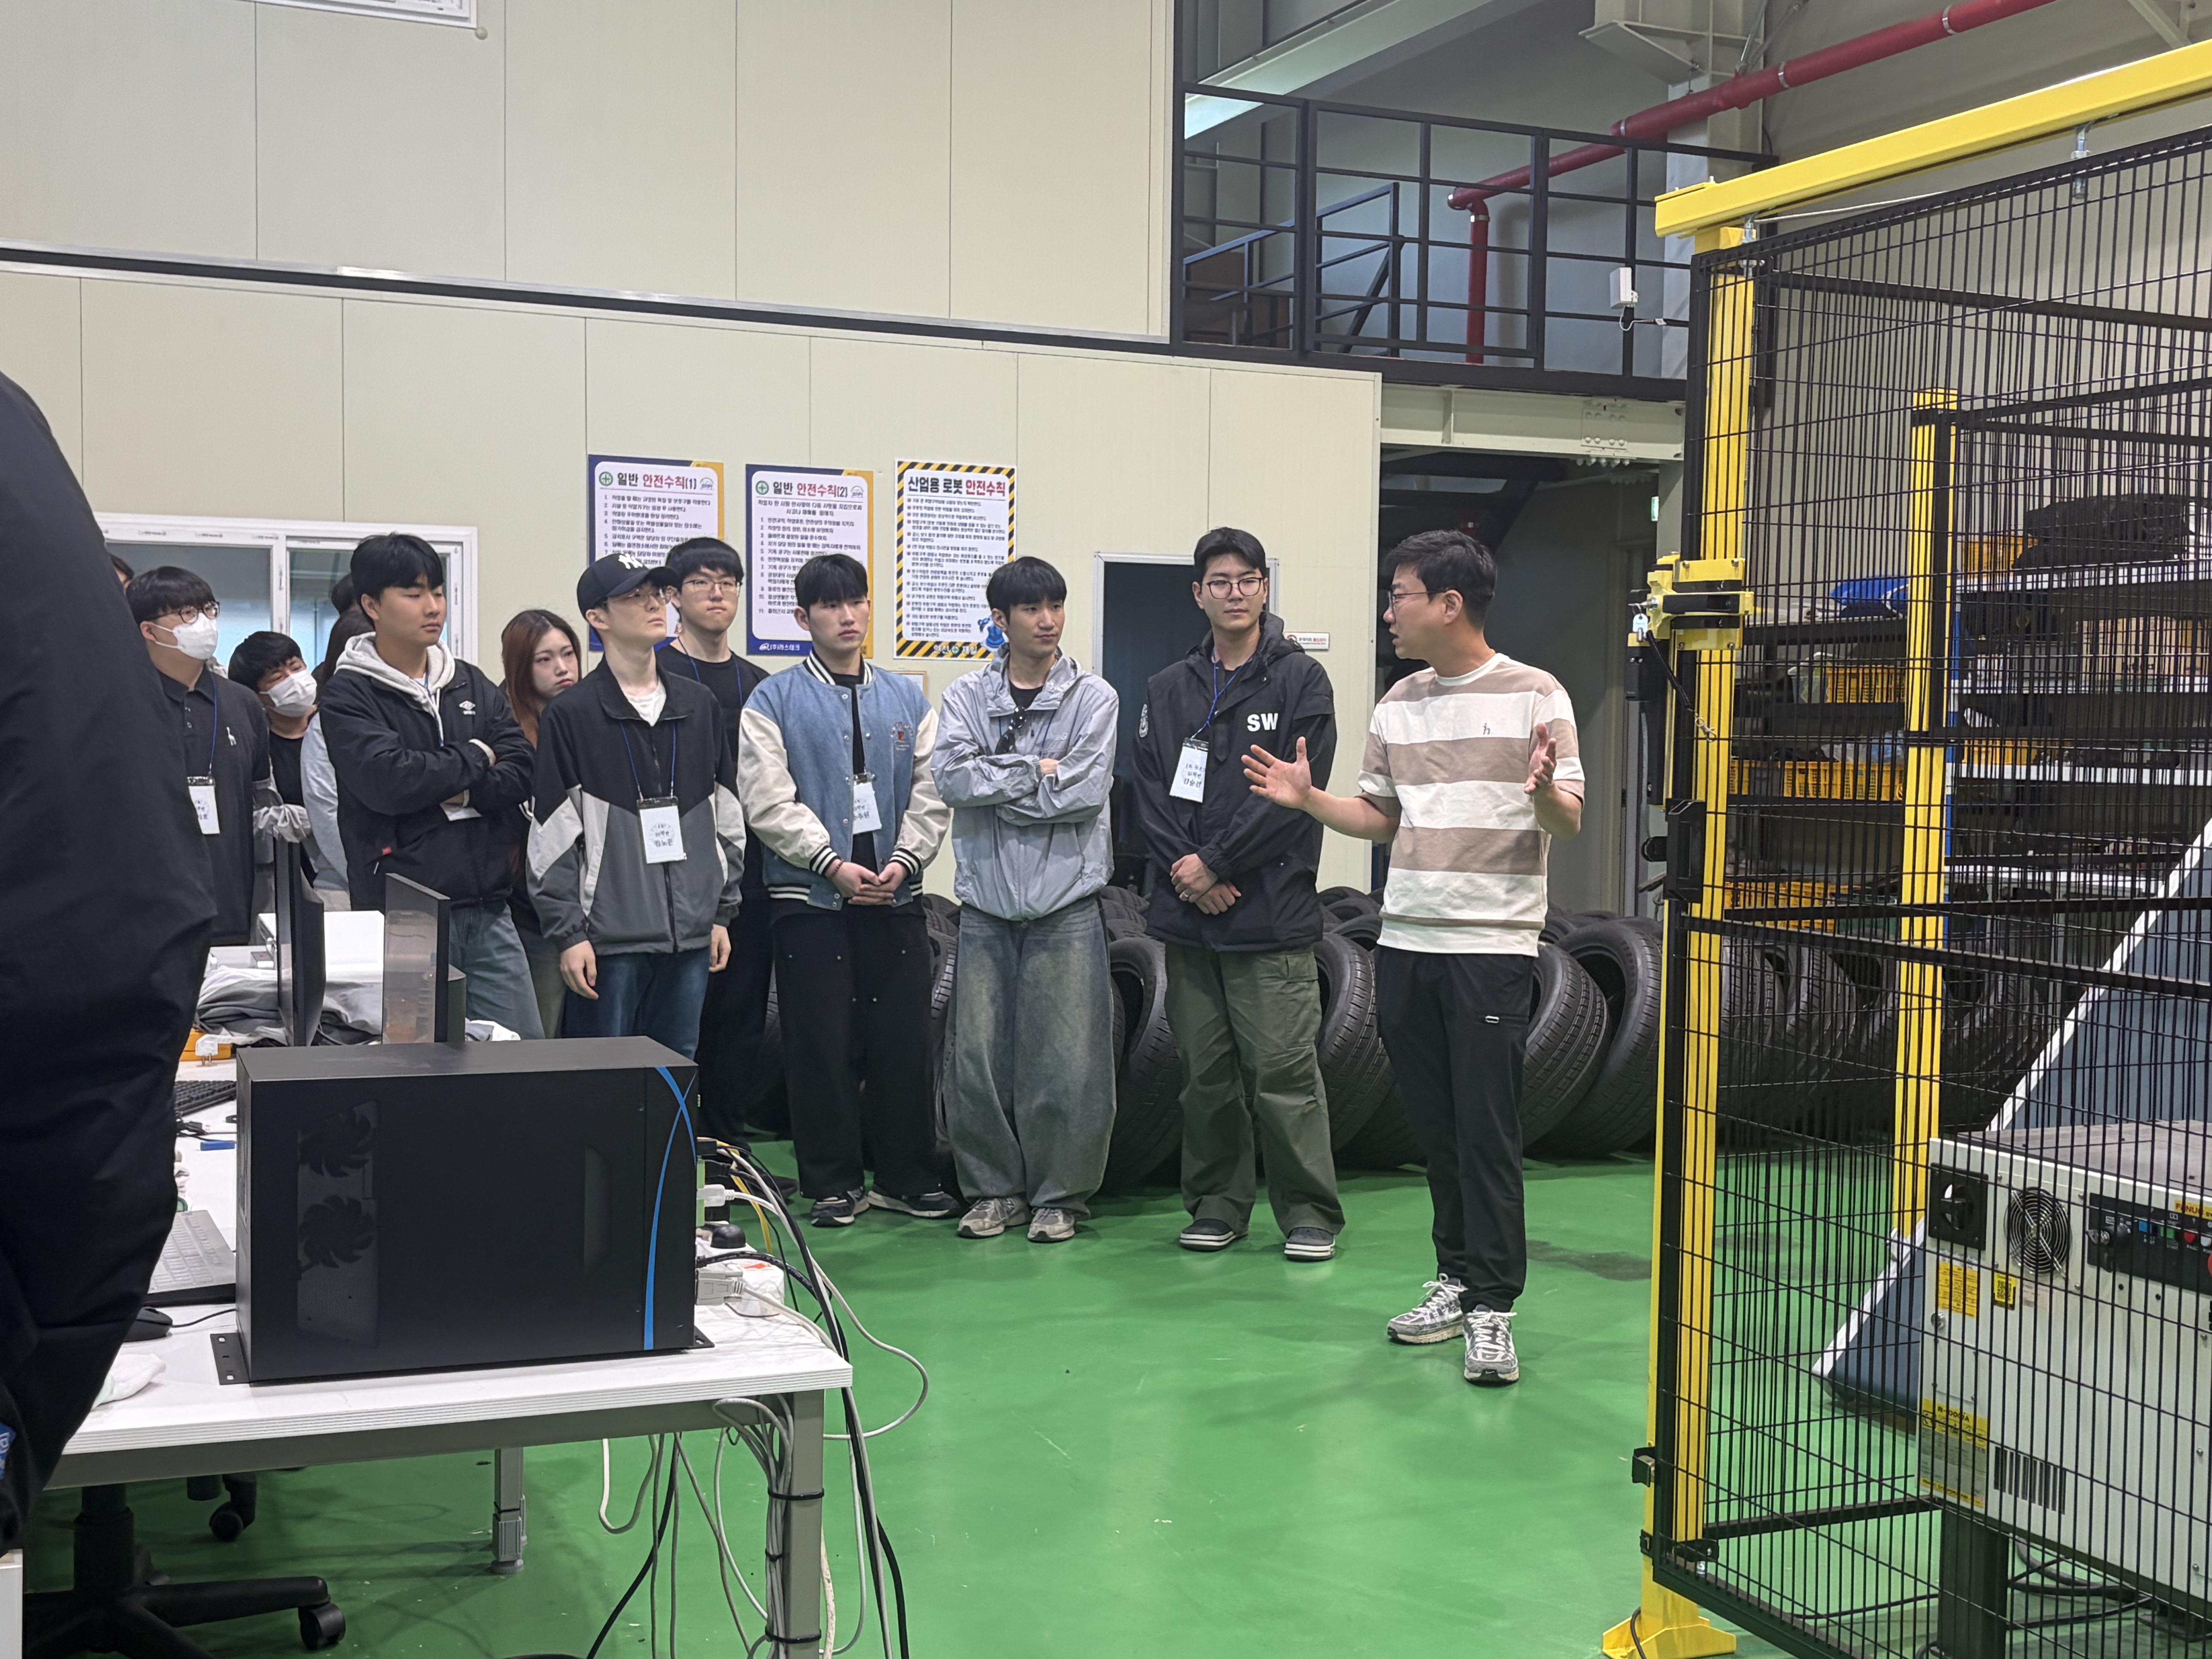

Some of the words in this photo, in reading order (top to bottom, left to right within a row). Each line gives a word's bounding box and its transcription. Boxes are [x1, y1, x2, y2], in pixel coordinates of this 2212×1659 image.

[617, 472, 638, 487] 일반
[643, 474, 697, 489] 안전수칙(1)
[908, 476, 939, 493] 산업용
[943, 478, 962, 494] 로봇
[966, 479, 1006, 496] 안전수칙
[773, 481, 793, 495] 일반
[797, 483, 848, 498] 안전수칙(2)
[1247, 713, 1278, 732] SW
[2176, 1203, 2203, 1216] FNU
